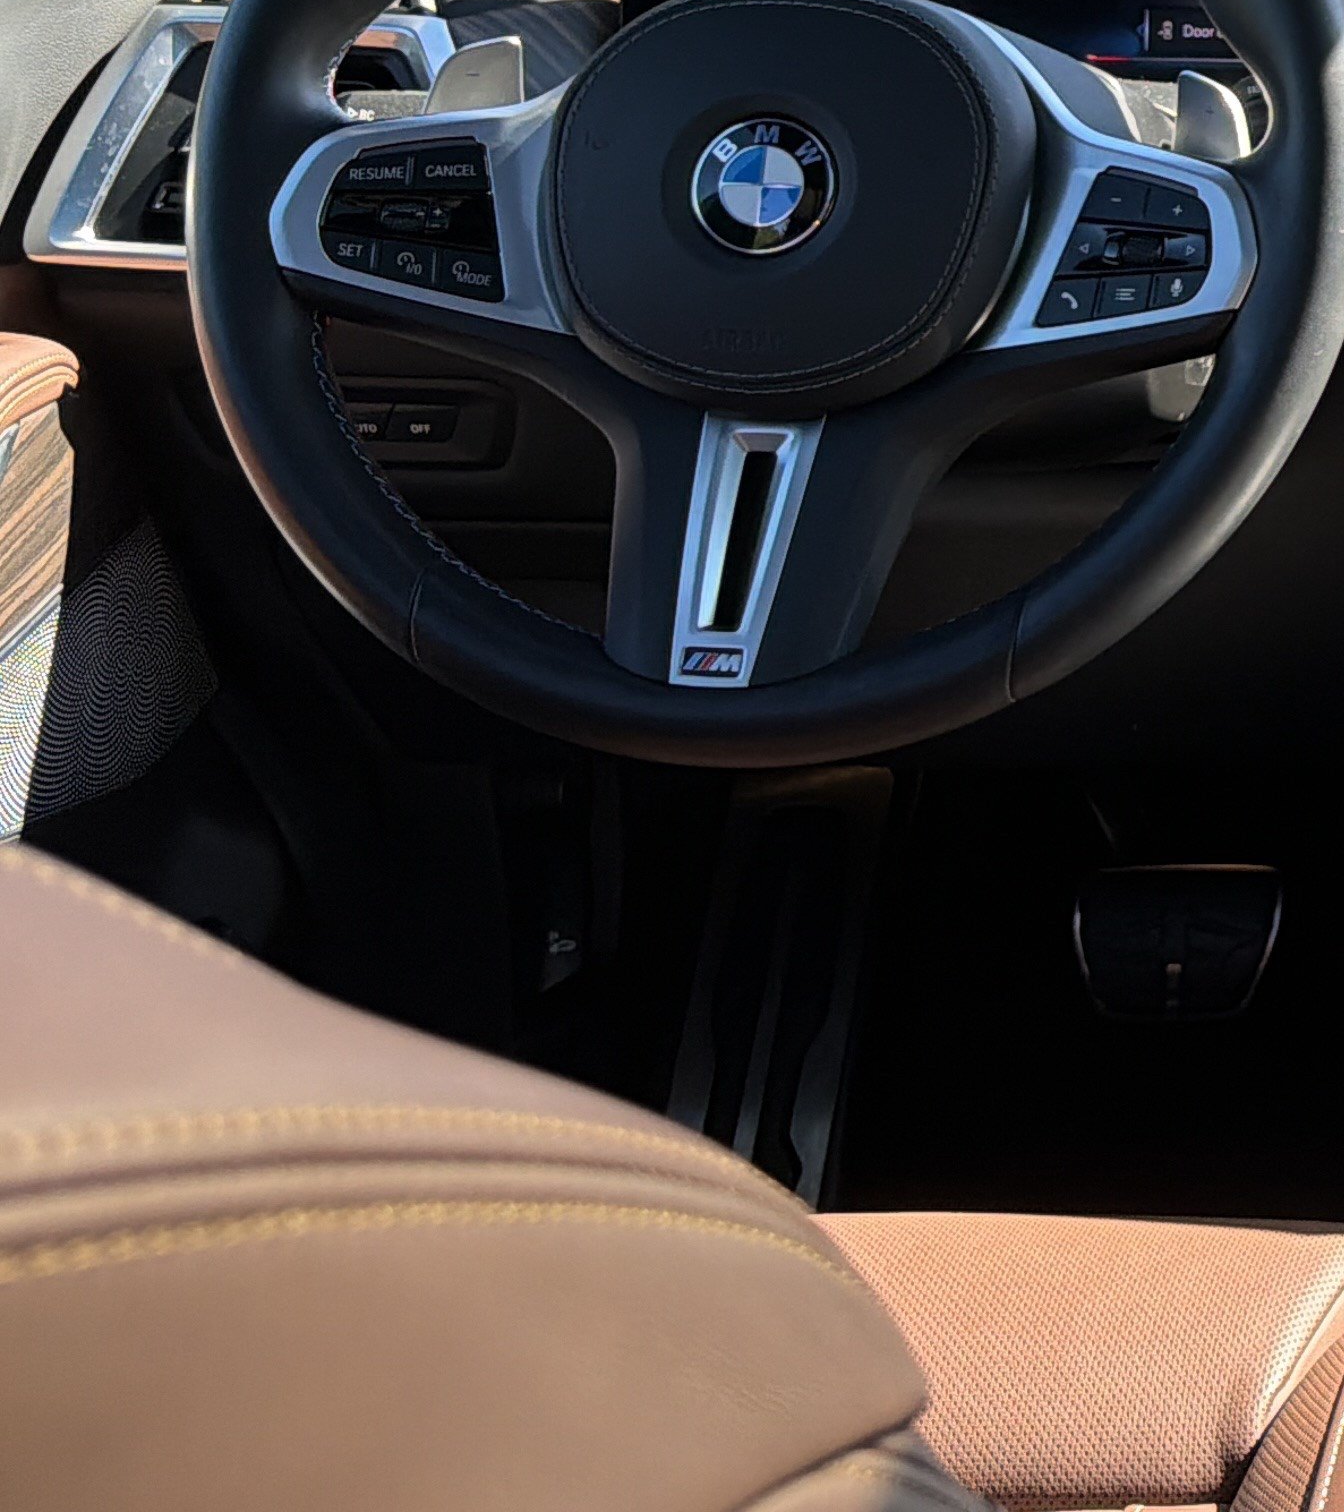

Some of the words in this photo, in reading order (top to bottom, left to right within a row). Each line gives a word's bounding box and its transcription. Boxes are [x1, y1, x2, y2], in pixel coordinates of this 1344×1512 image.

[1181, 23, 1215, 38] Door
[359, 108, 376, 122] BC
[712, 124, 822, 166] BMW
[349, 165, 405, 181] RESUME
[425, 163, 477, 178] CANCEL
[337, 242, 364, 258] SET
[456, 270, 492, 286] MODE
[409, 423, 431, 434] OFF
